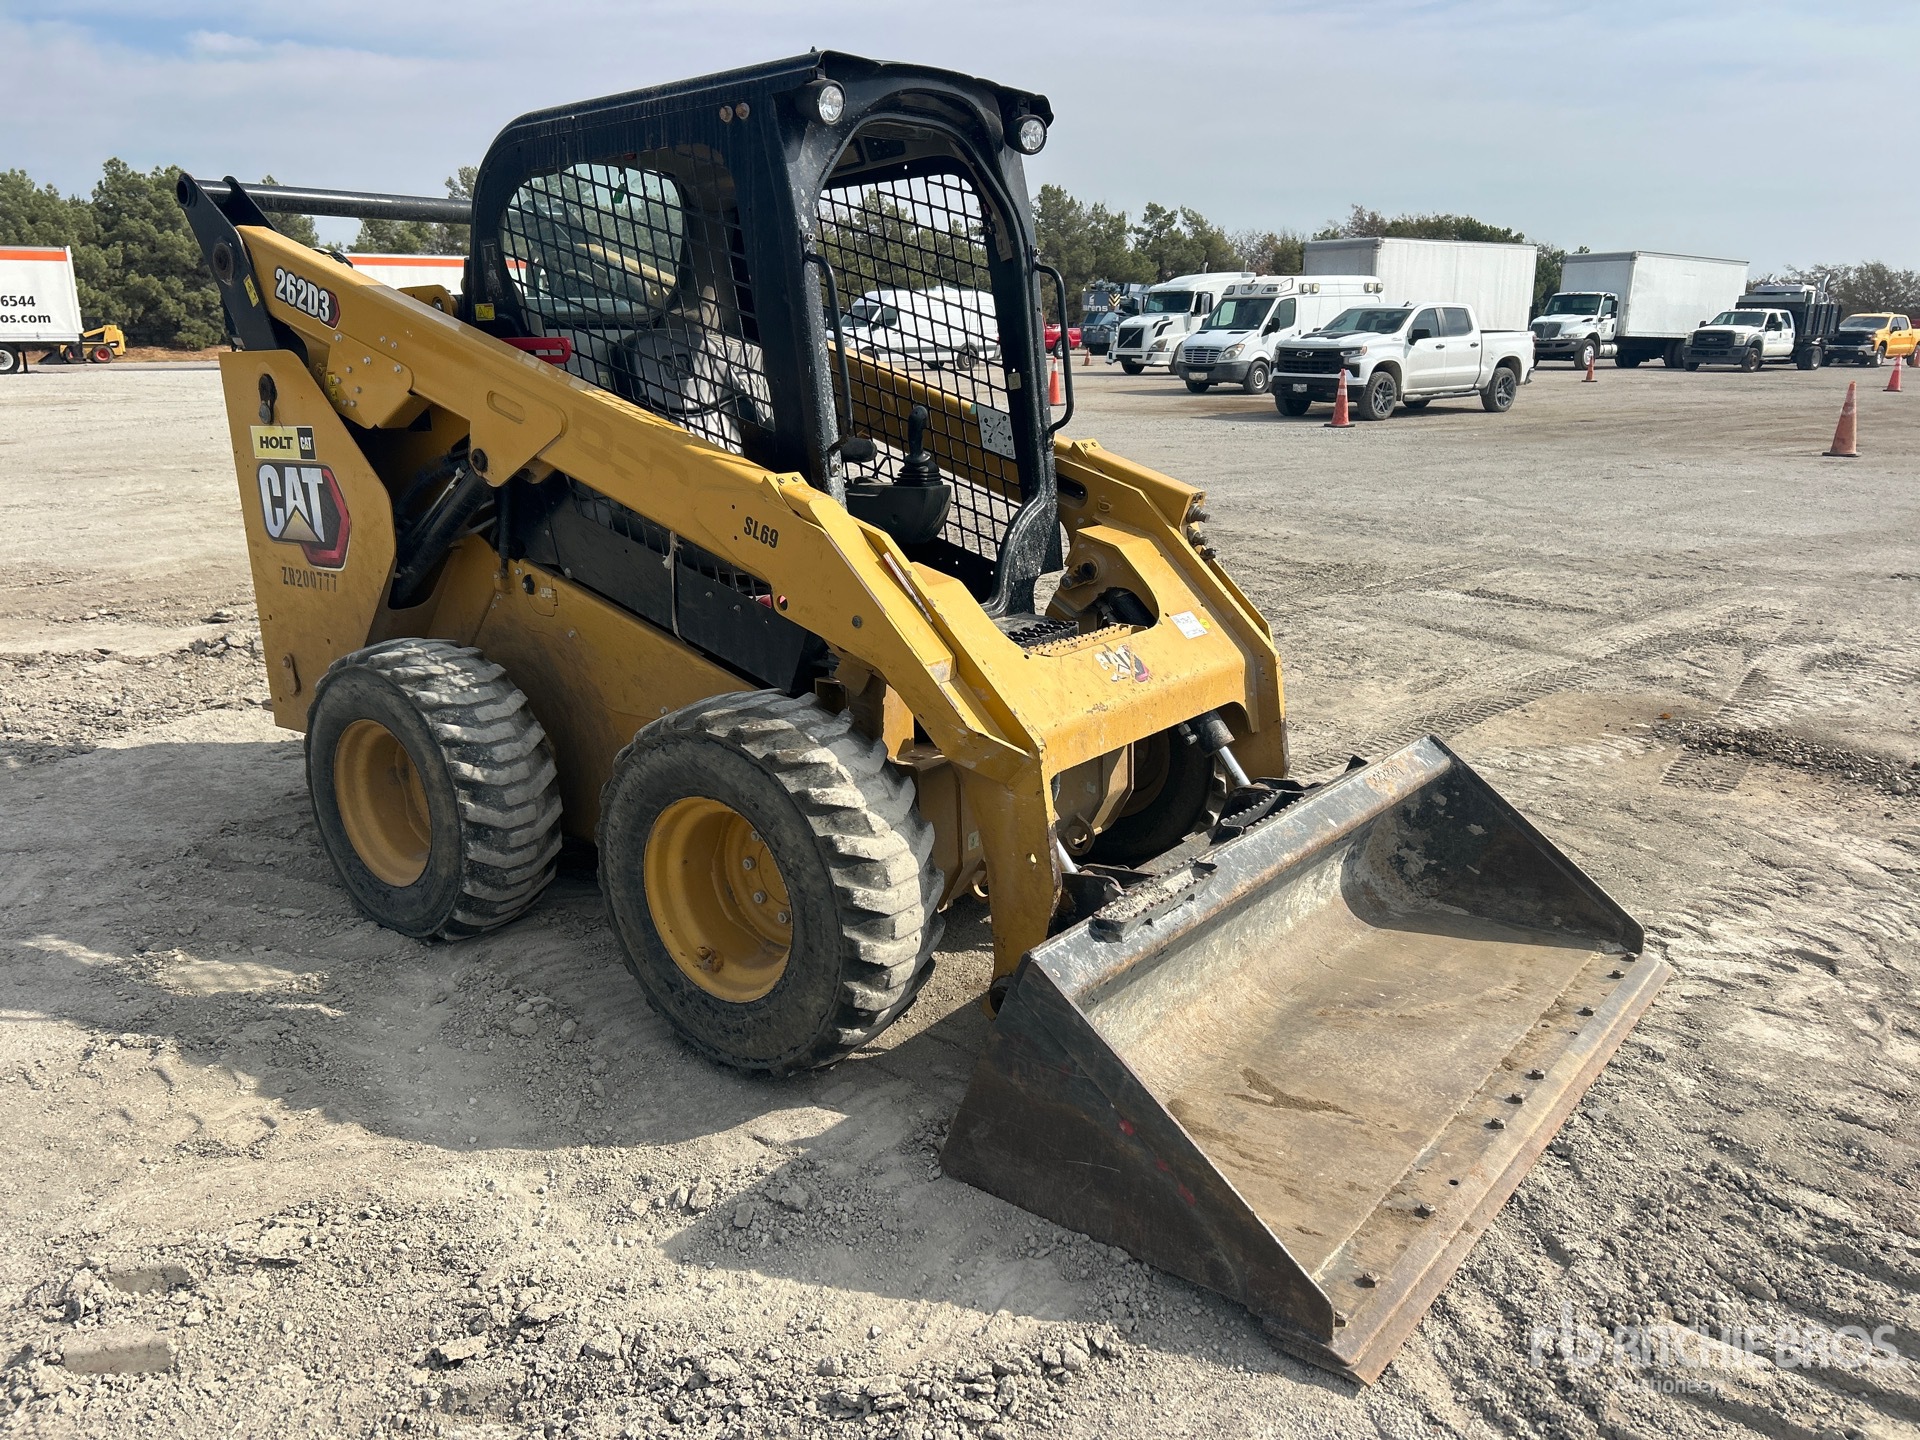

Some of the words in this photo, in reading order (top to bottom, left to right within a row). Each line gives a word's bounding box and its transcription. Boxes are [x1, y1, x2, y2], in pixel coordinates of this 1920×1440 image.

[0, 295, 36, 307] 6544
[275, 268, 330, 322] 262D3
[259, 436, 293, 450] HOLT
[300, 436, 312, 449] CAT
[258, 464, 325, 543] CAT
[743, 516, 779, 548] SL69
